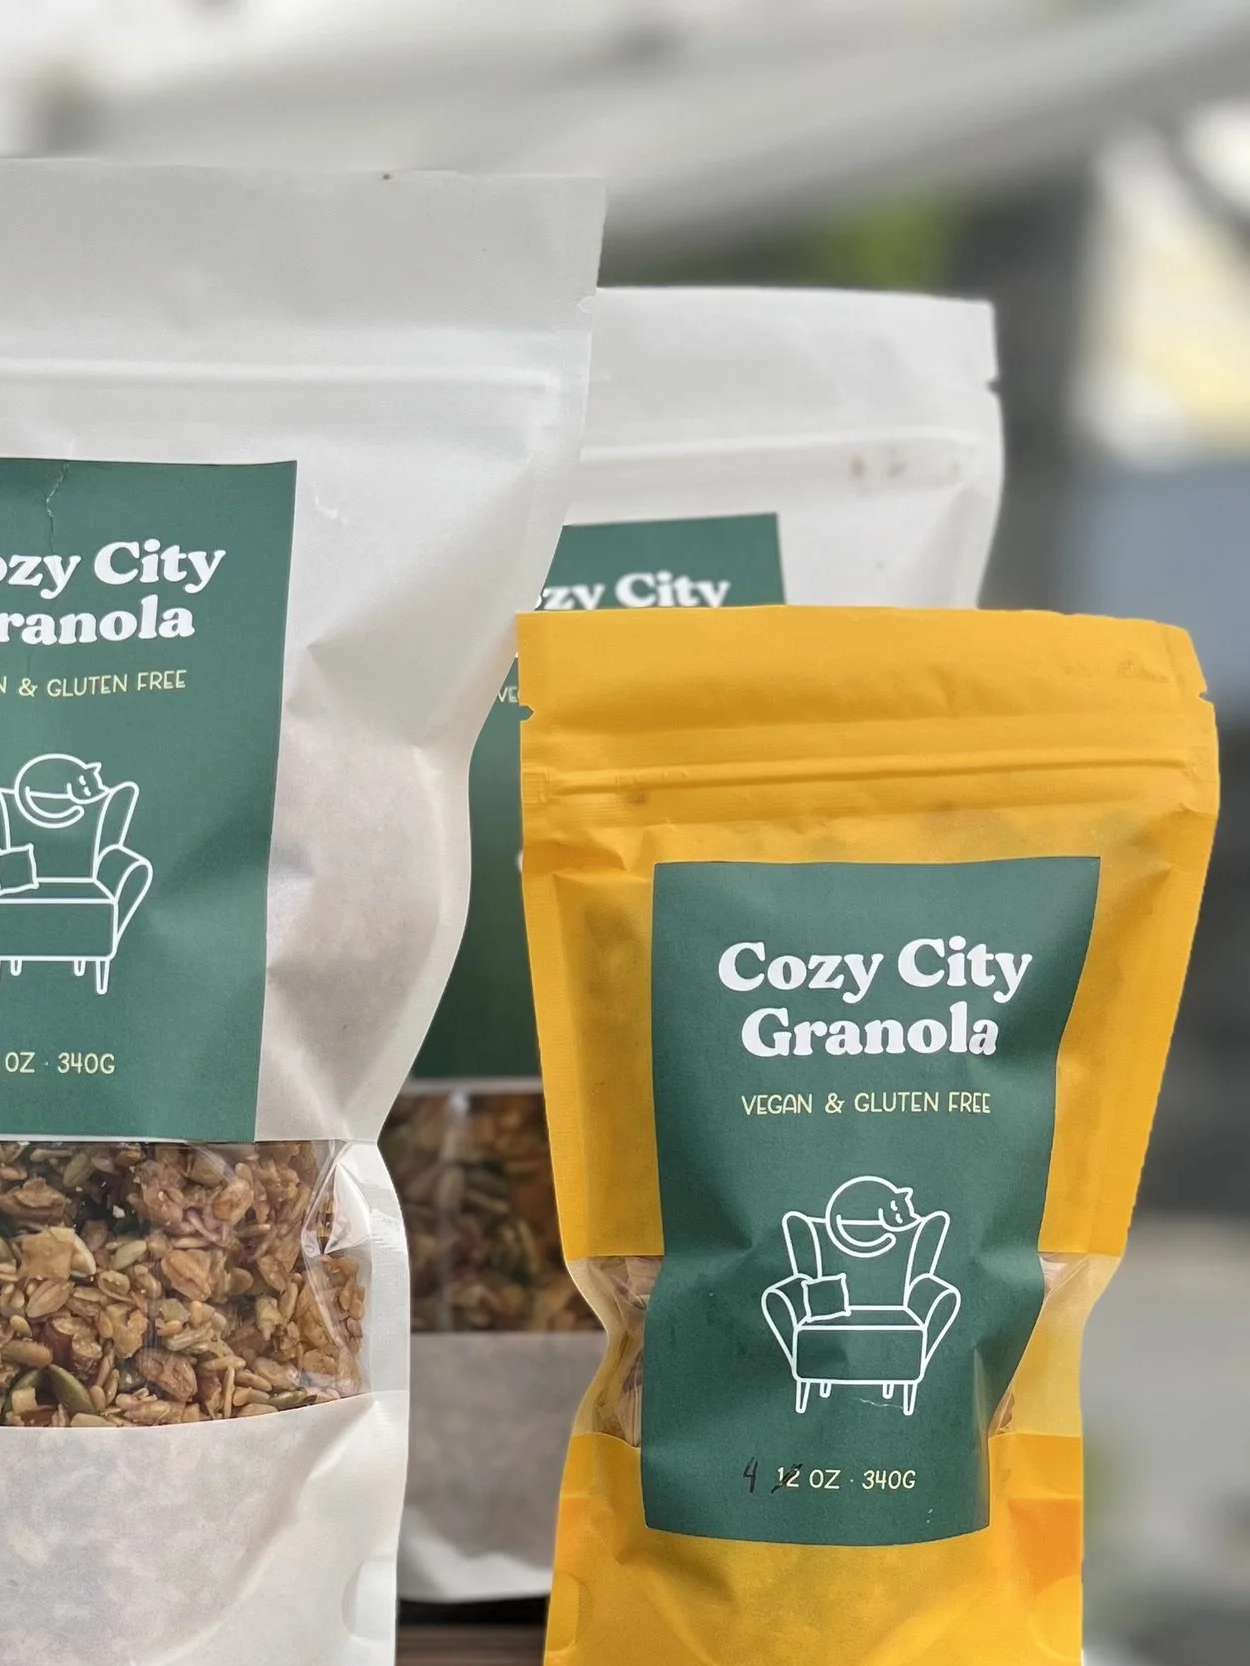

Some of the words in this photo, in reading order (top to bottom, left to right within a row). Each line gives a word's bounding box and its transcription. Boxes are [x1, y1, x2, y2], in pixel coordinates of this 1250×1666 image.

[94, 538, 227, 595] City
[535, 583, 605, 610] zy
[615, 571, 731, 607] City
[17, 677, 39, 698] &
[47, 672, 128, 697] GLUTEN
[137, 669, 187, 690] FREE
[717, 942, 884, 1004] Cozy
[896, 935, 1033, 1004] City
[740, 1000, 997, 1058] Granola
[4, 1051, 36, 1074] OZ
[57, 1051, 115, 1075] 340G
[741, 1092, 813, 1116] VEGAN
[824, 1092, 845, 1117] &
[854, 1090, 939, 1115] GLUTEN
[948, 1092, 991, 1114] FREE
[743, 1456, 759, 1493] 4
[809, 1469, 842, 1489] OZ
[861, 1469, 916, 1490] 340G
